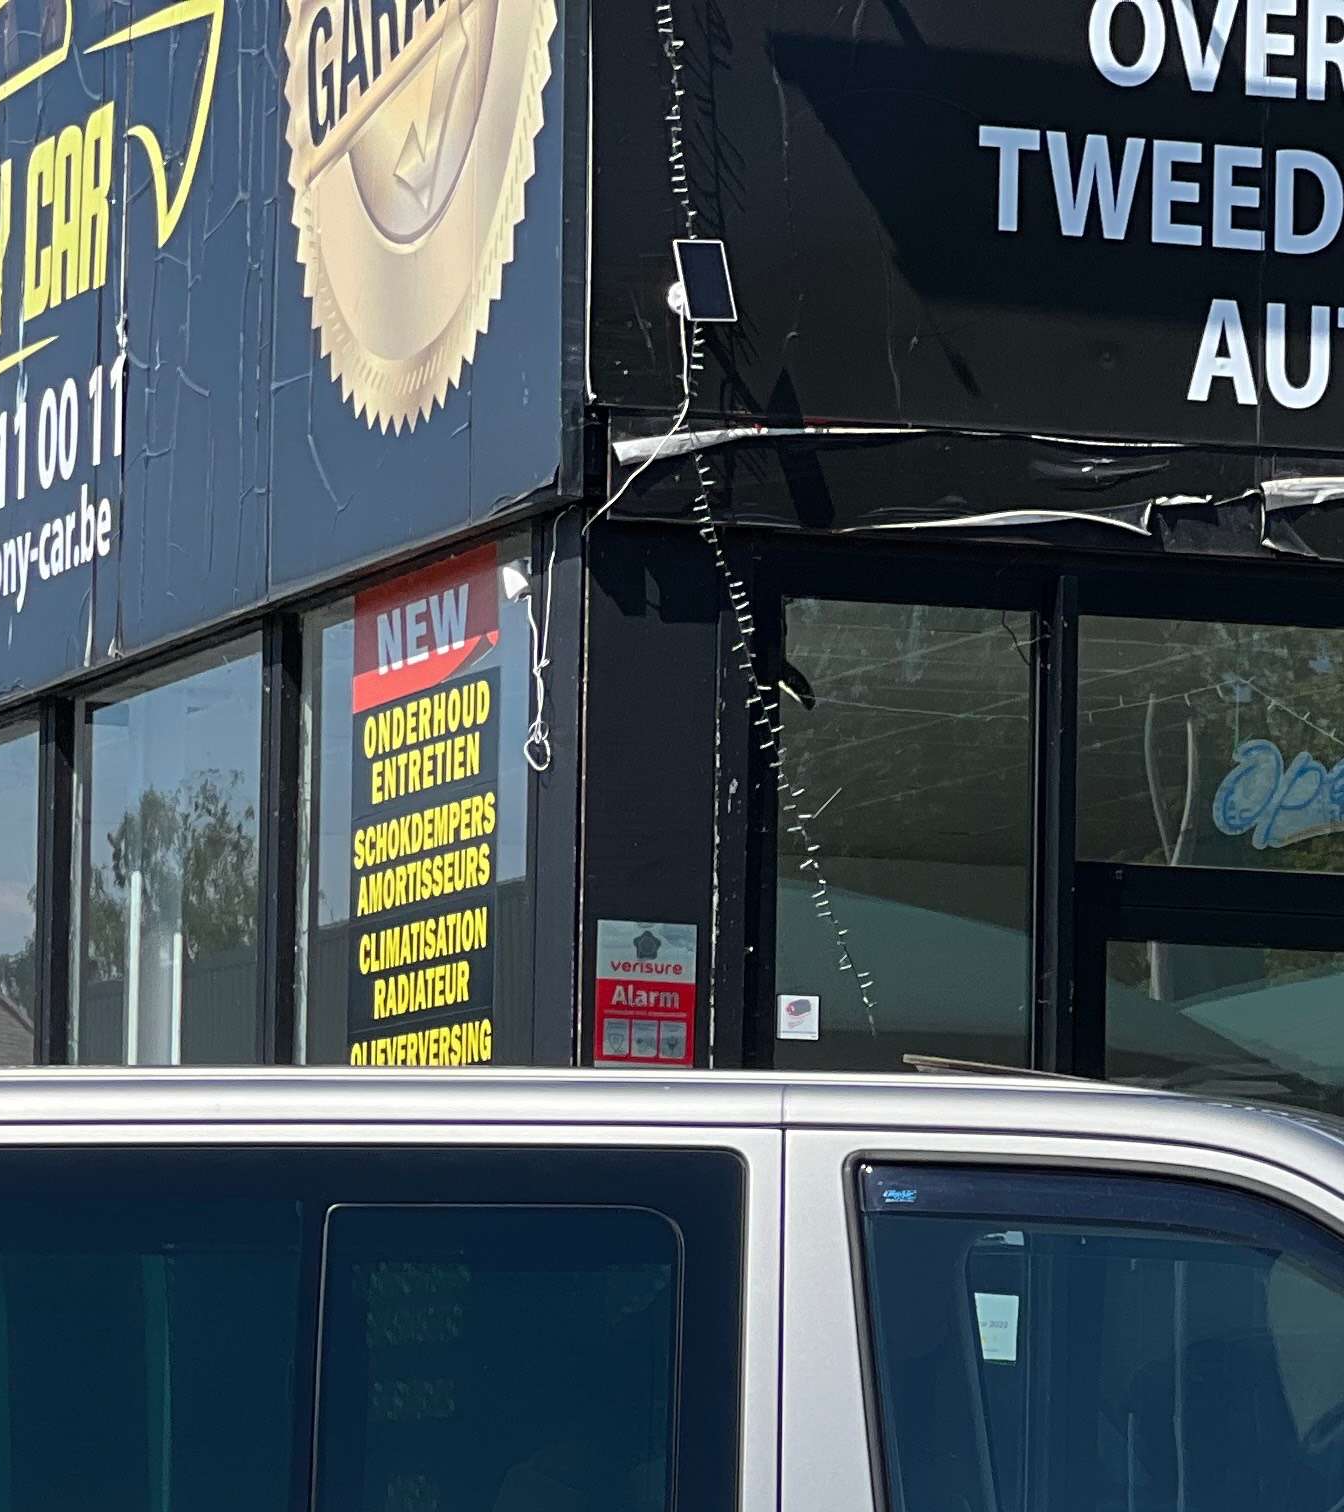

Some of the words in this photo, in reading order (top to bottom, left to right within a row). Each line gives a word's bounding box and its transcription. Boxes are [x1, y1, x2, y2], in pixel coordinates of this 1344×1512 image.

[23, 101, 114, 322] CAR
[38, 377, 79, 490] 00
[89, 353, 127, 467] 11
[377, 583, 469, 676] NEW
[363, 680, 491, 759] ONDERHOUD
[371, 731, 481, 805] ENTRETIEN
[354, 792, 496, 870] SCHOKDEMPERS
[356, 843, 490, 917] AMORTISSEURS
[359, 906, 487, 975] CLIMATISATION
[610, 960, 683, 976] verisure
[373, 960, 470, 1021] RADIATEUR
[611, 984, 680, 1009] Alarm
